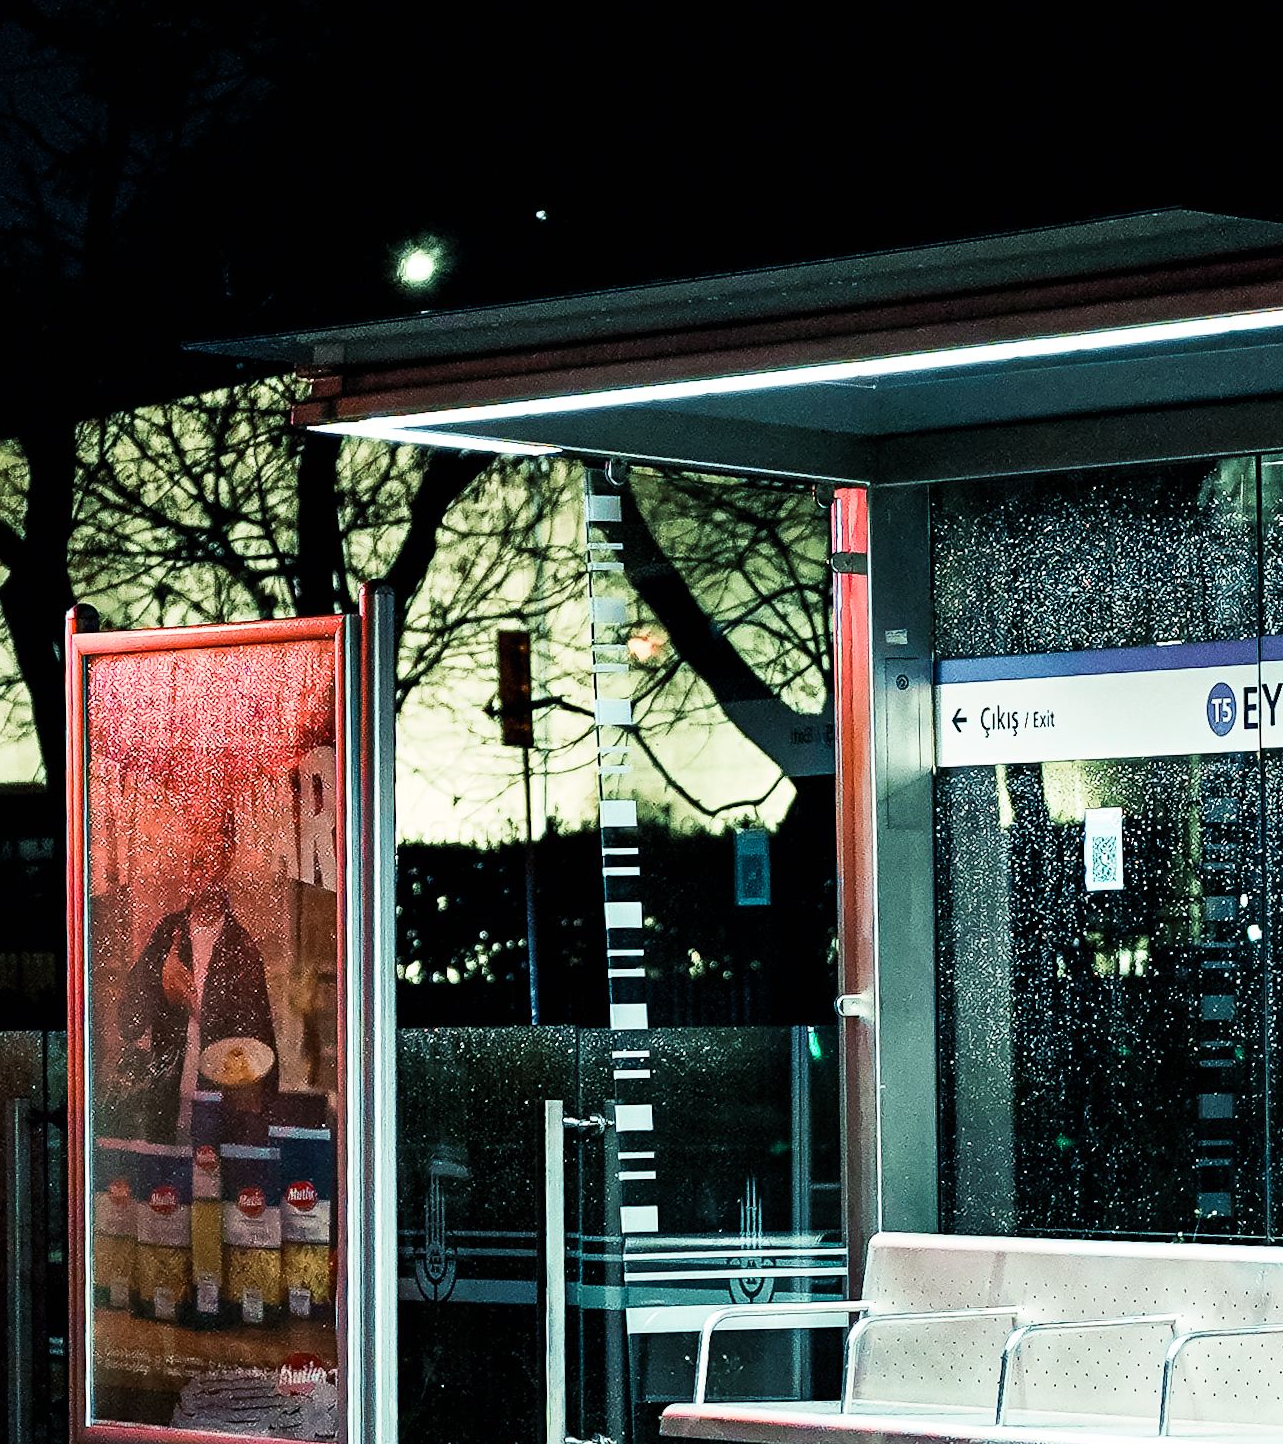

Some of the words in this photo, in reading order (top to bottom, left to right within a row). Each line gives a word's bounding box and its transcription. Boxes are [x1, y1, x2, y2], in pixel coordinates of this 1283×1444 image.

[980, 704, 1019, 738] Çıkış
[1033, 709, 1056, 728] Exit
[1211, 697, 1233, 724] T5
